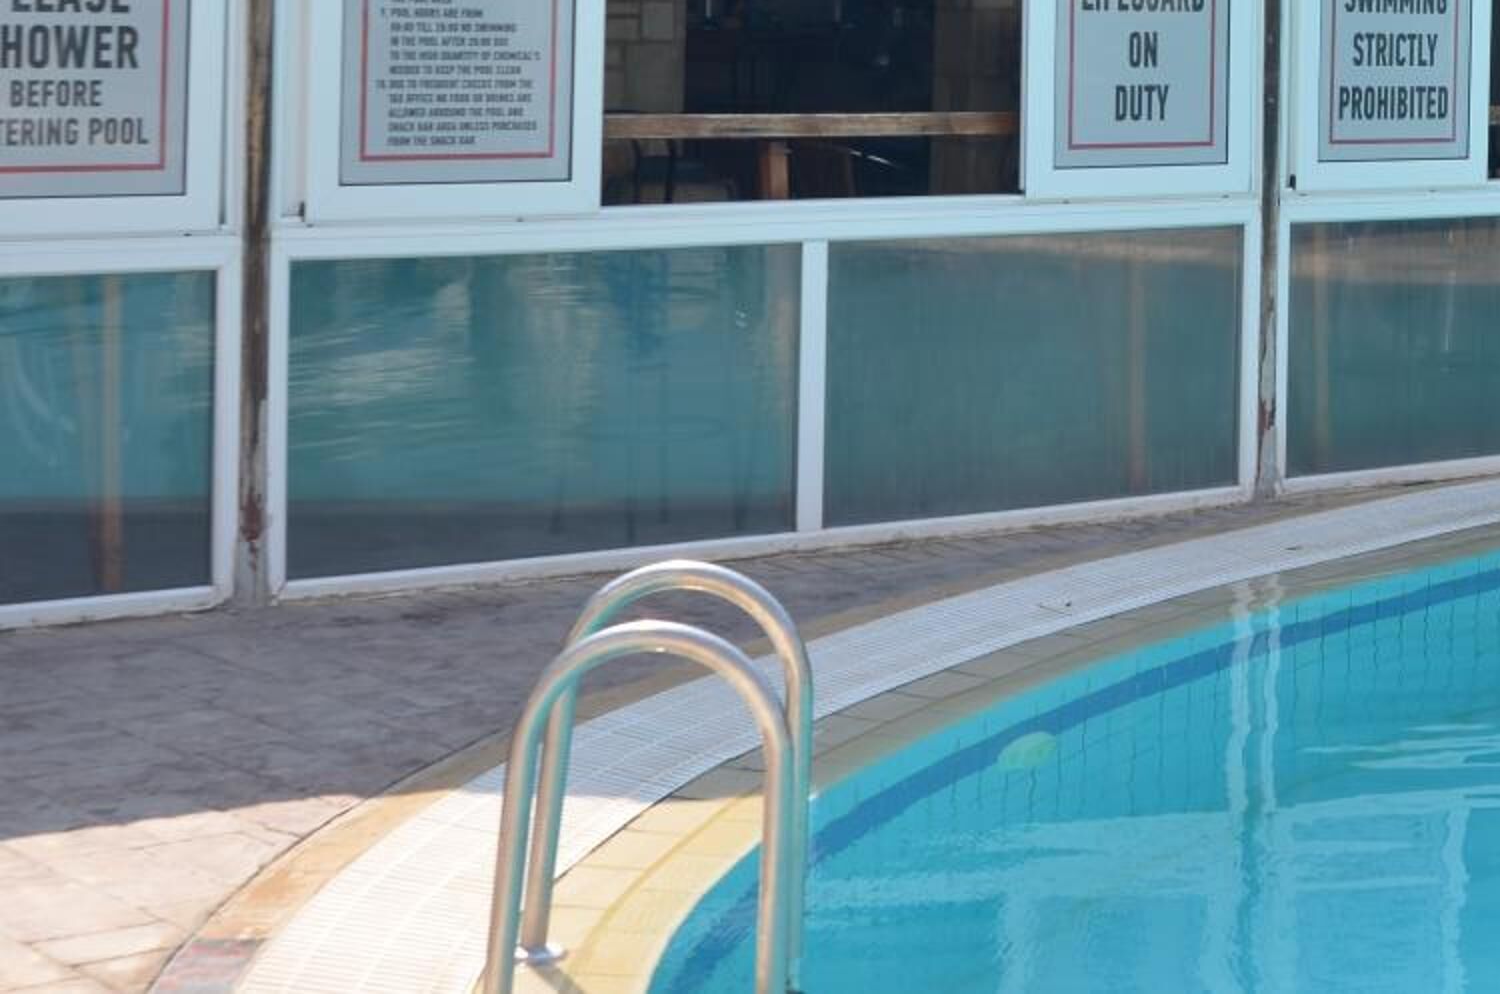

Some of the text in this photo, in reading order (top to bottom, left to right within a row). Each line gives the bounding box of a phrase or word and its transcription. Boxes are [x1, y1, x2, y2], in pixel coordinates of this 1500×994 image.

[1128, 31, 1158, 68] ON
[1352, 33, 1438, 68] STRICTLY
[10, 79, 103, 107] BEFORE
[1114, 84, 1169, 122] DUTY
[1338, 85, 1449, 121] PROHIBITED
[88, 117, 149, 146] POOL
